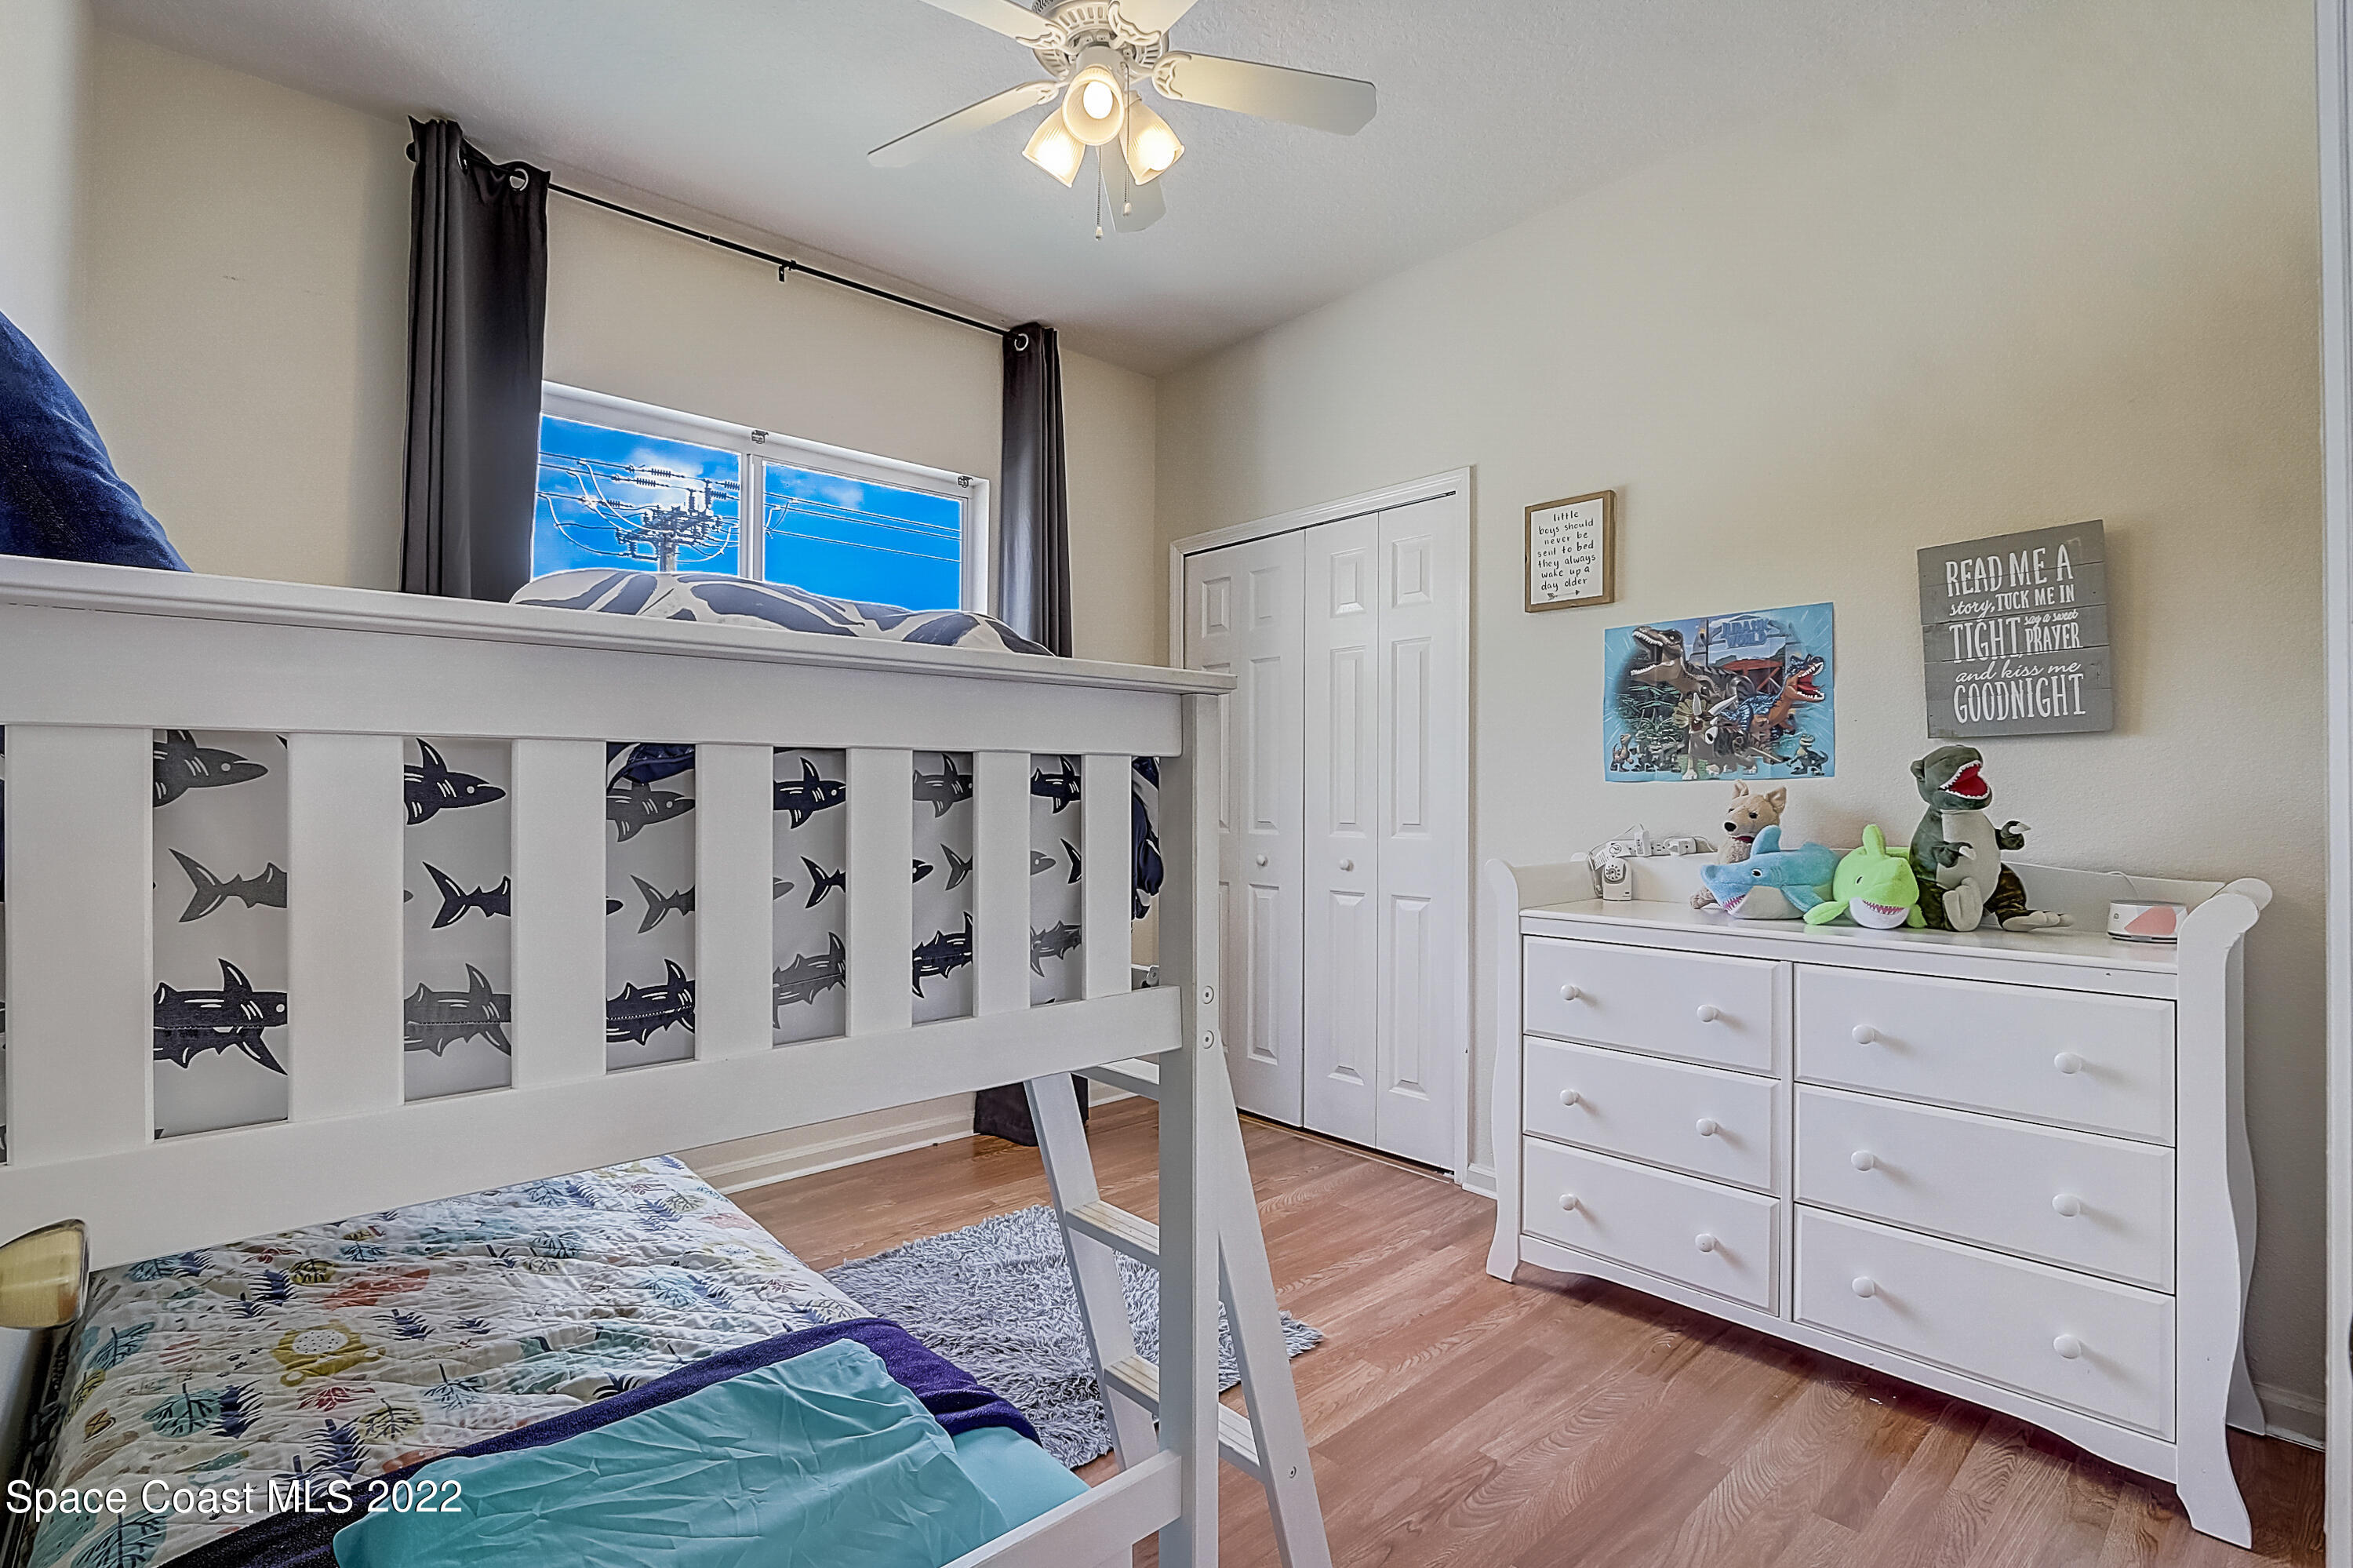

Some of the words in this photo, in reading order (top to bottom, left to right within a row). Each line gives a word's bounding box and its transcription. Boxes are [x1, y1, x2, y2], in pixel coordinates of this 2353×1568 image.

[1553, 510, 1579, 522] little
[1538, 526, 1559, 537] boys
[1564, 518, 1594, 531] should
[1537, 548, 1556, 558] sent
[1577, 540, 1594, 551] bed
[1544, 536, 1570, 545] never
[1538, 559, 1559, 570] they
[1564, 554, 1596, 566] always
[1945, 555, 2002, 597] READ
[2009, 548, 2048, 587] ME
[2056, 544, 2074, 581] A
[1541, 569, 1563, 579] wake
[1569, 567, 1581, 577] up
[1540, 580, 1558, 591] day
[1564, 577, 1587, 588] older
[1995, 590, 2029, 612] TUCK
[2035, 587, 2055, 606] ME
[2060, 584, 2075, 603] IN
[2024, 615, 2042, 628] say
[2042, 613, 2051, 623] a
[2052, 609, 2078, 622] sweet
[2024, 622, 2084, 655] PRAYER
[1955, 660, 1998, 683] and
[2001, 659, 2046, 679] kiss
[2047, 661, 2082, 674] me
[1953, 673, 2086, 724] GOODNIGHT
